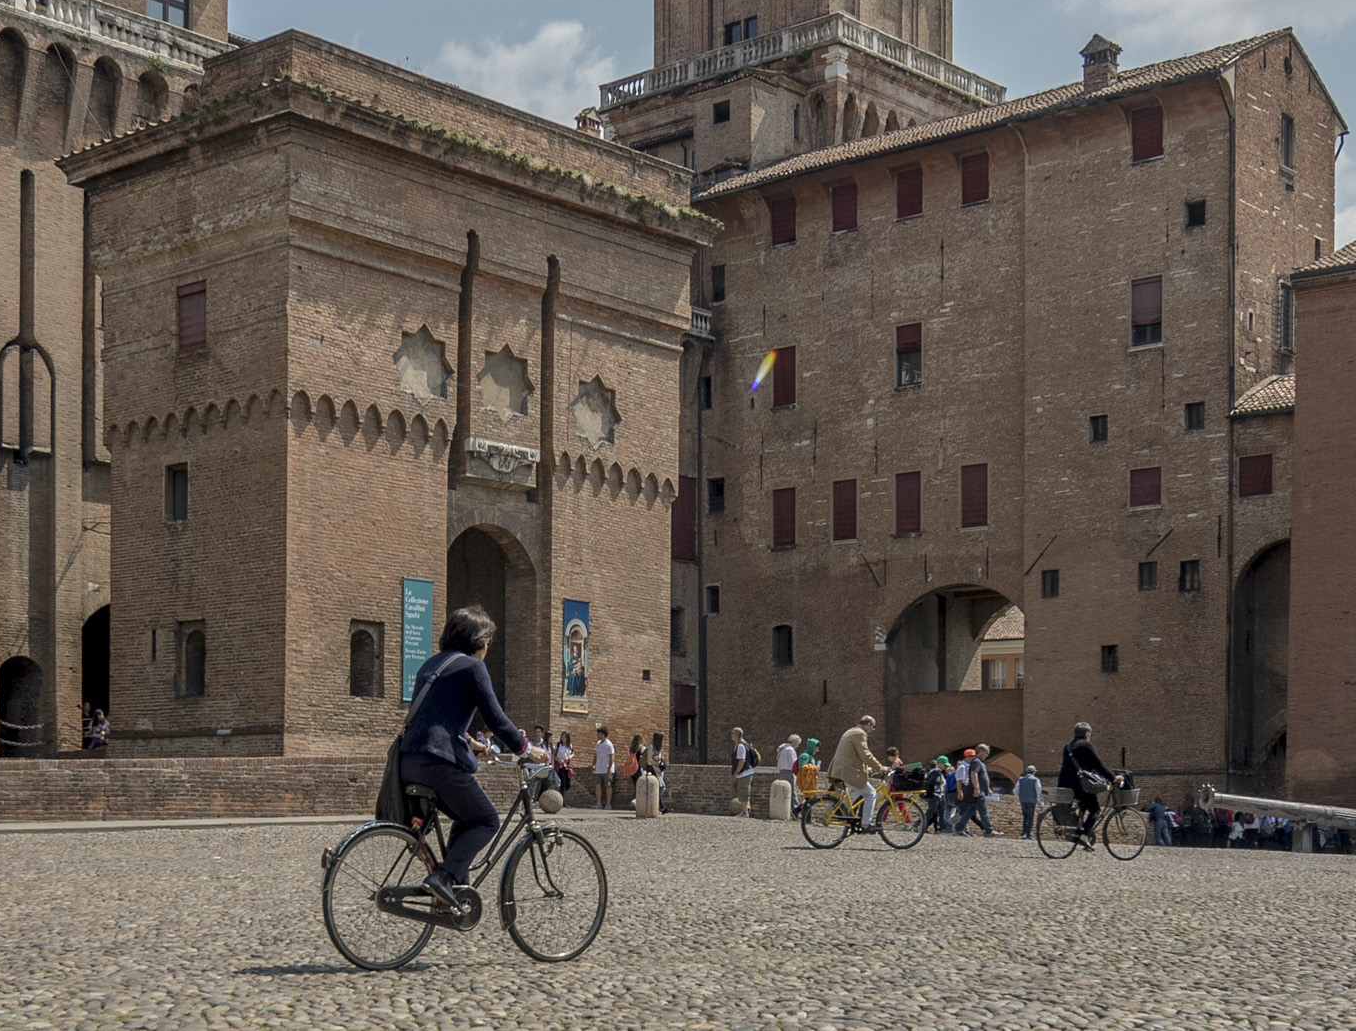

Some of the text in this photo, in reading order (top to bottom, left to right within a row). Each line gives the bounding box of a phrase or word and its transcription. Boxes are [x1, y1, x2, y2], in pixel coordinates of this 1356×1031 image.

[405, 596, 429, 605] Collezione
[405, 603, 426, 612] Cavallini
[405, 611, 420, 619] Sgarbi
